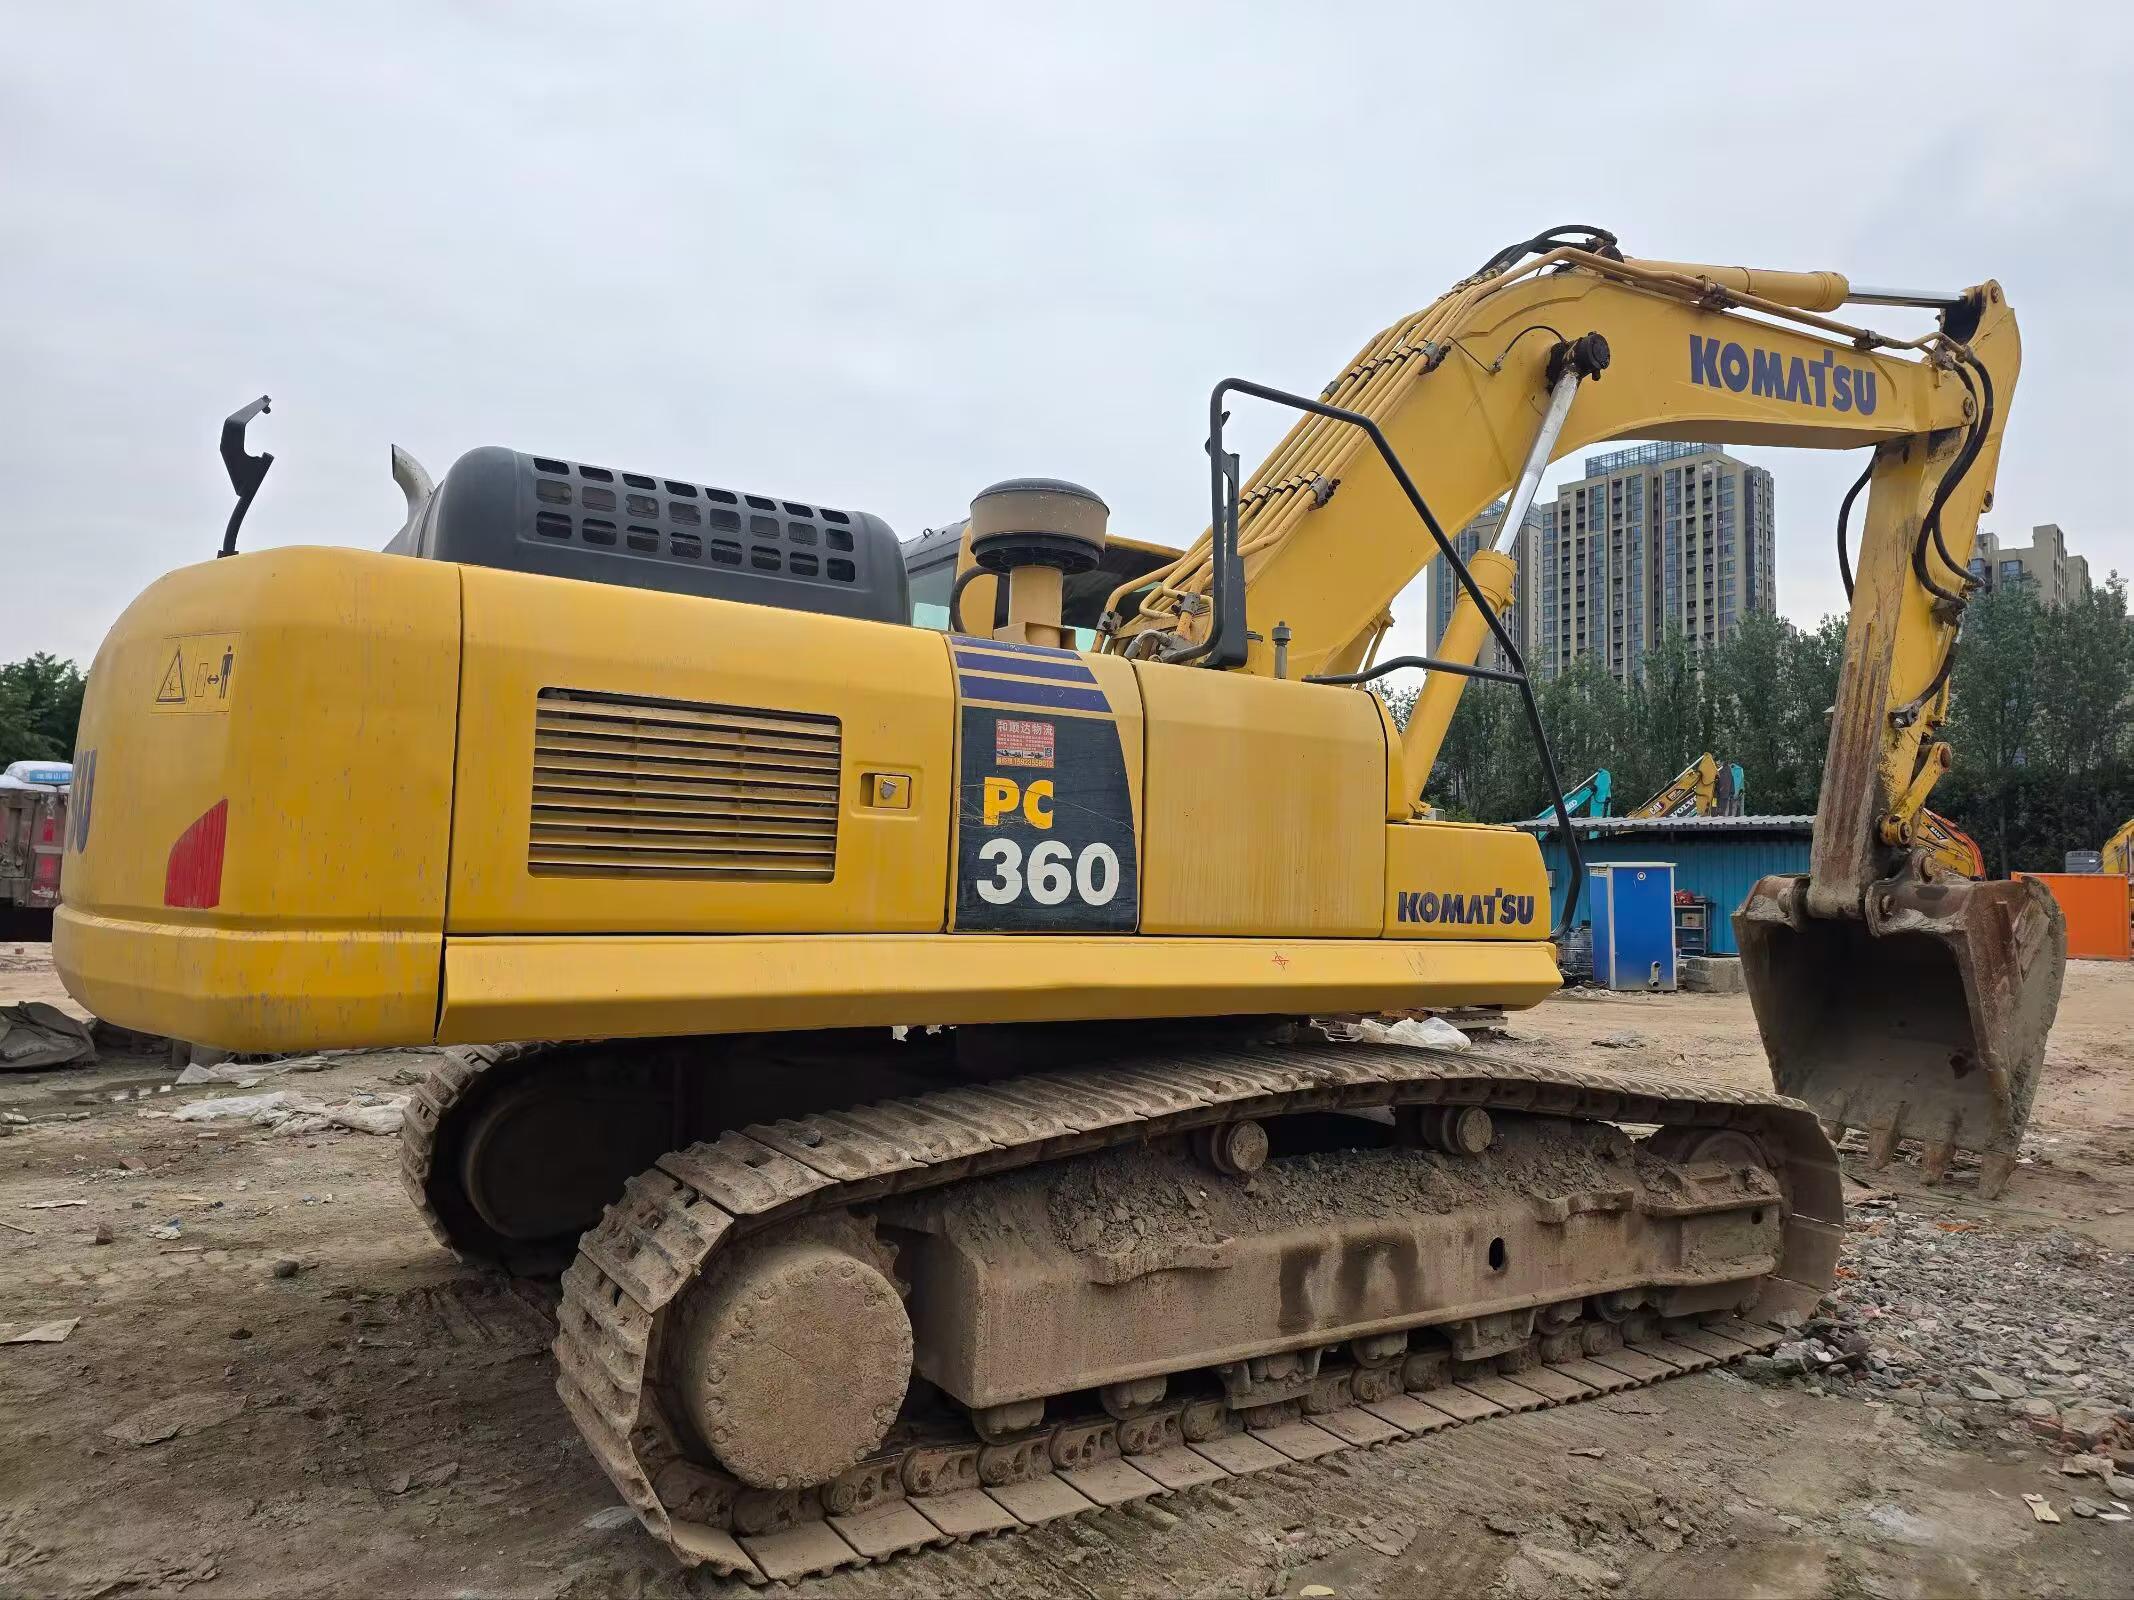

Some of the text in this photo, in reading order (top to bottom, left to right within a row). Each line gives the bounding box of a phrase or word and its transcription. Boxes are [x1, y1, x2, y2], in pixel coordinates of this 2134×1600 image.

[1689, 334, 1877, 416] KOMATSU
[997, 720, 1054, 736] 和顺达物流
[983, 776, 1054, 829] PC
[1649, 801, 1663, 815] CAT
[1929, 826, 1946, 840] SANY
[976, 838, 1120, 906] 360
[1397, 887, 1535, 925] KOMATSU
